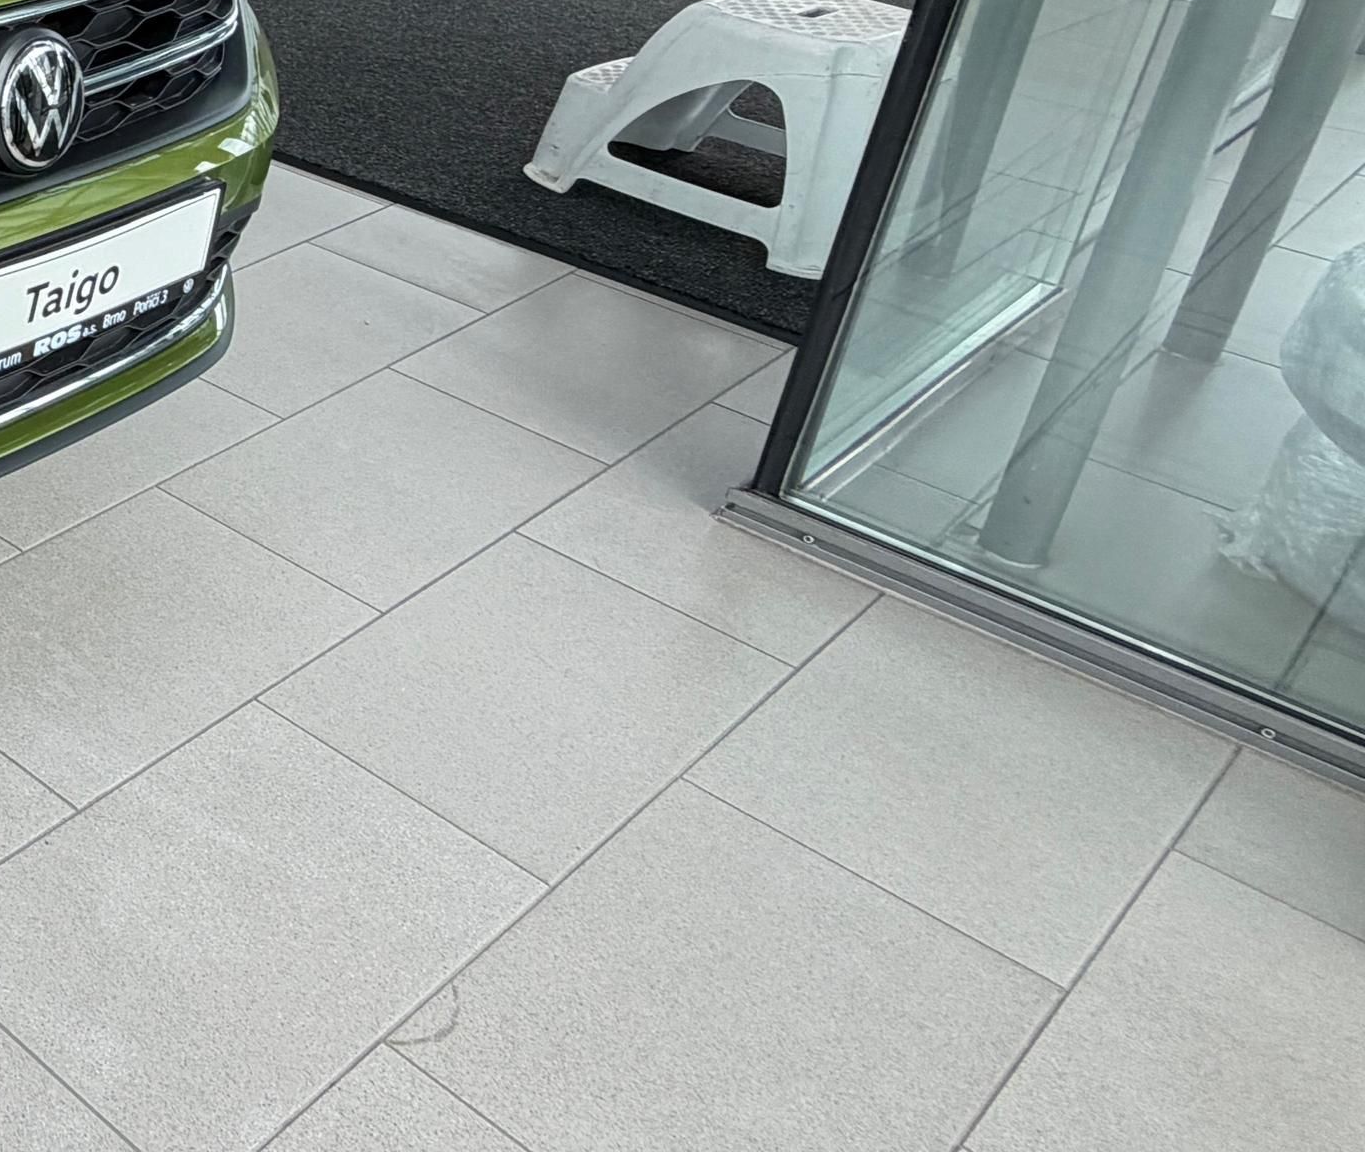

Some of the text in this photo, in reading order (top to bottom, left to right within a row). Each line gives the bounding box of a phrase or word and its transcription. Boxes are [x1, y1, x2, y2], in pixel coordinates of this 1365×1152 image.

[5, 42, 80, 163] VW
[26, 264, 120, 324] Taigo
[33, 323, 82, 357] ROS
[102, 309, 127, 330] Brno
[160, 289, 169, 305] 3
